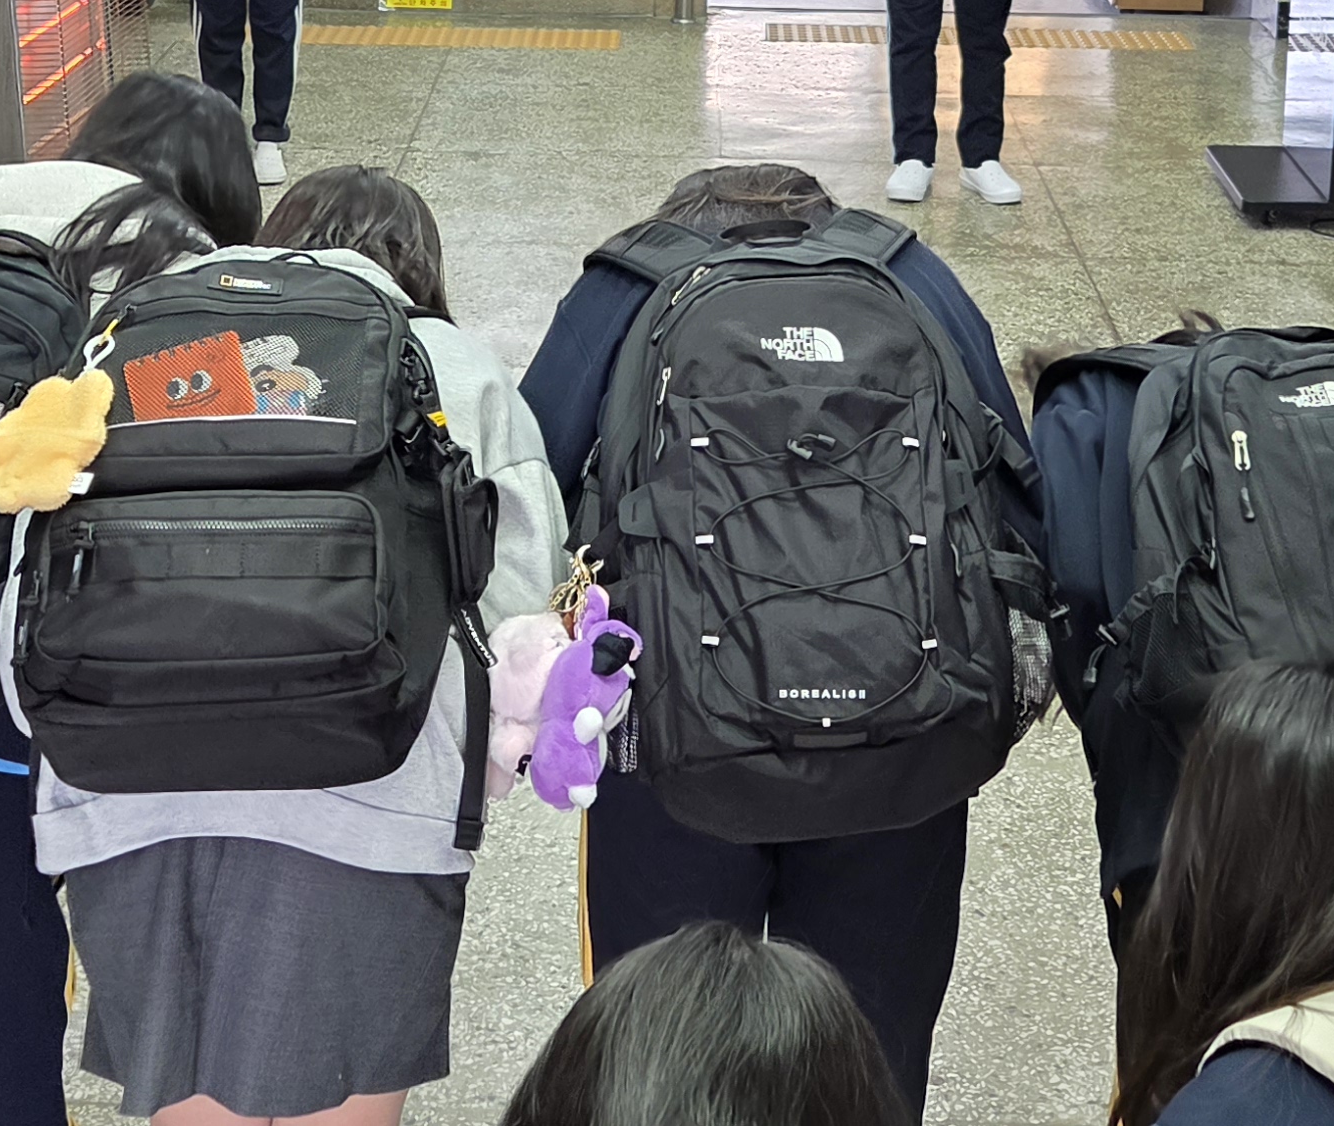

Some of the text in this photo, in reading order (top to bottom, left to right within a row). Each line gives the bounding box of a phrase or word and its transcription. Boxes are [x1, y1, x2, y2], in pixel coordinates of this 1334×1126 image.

[782, 327, 813, 339] THE
[760, 338, 814, 350] NORTH
[777, 349, 815, 361] FACE
